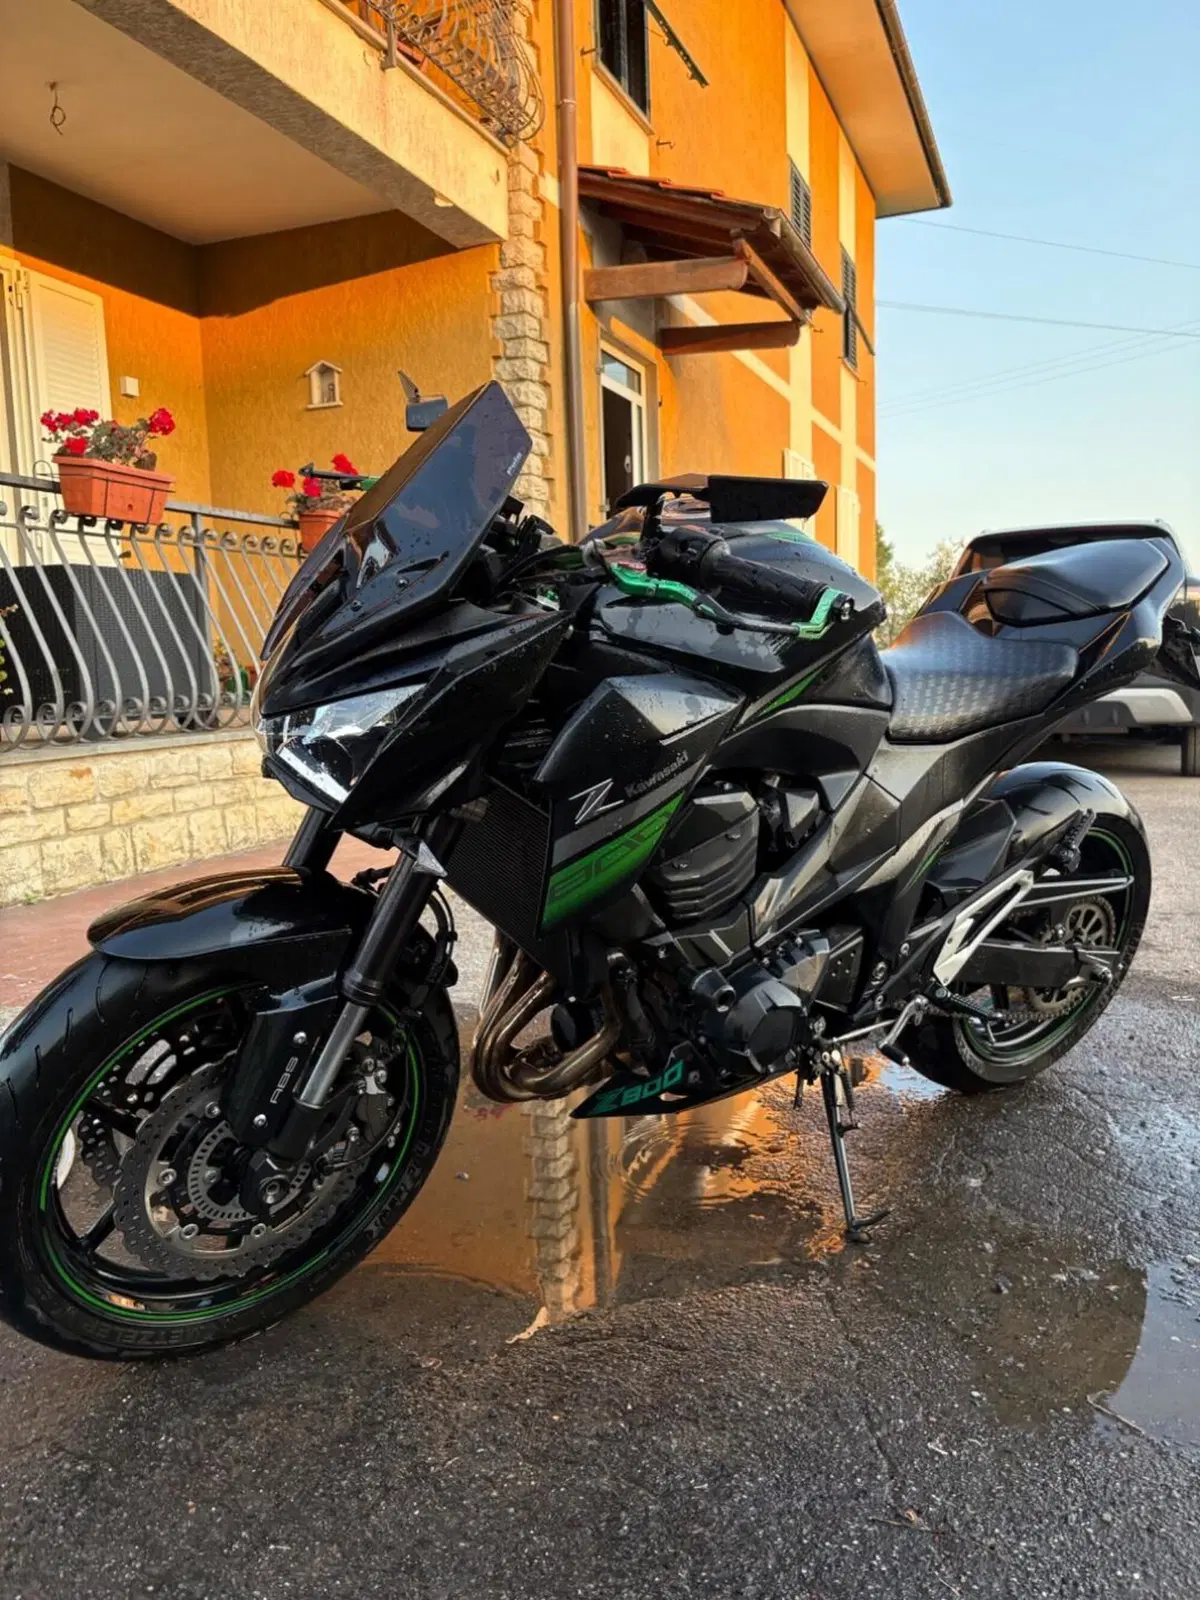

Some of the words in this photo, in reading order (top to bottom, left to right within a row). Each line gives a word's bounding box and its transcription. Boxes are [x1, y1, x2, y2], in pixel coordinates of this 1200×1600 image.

[624, 749, 689, 798] Kawasaki
[568, 778, 625, 825] Z
[270, 1056, 299, 1104] ABS
[588, 1059, 684, 1115] Z800
